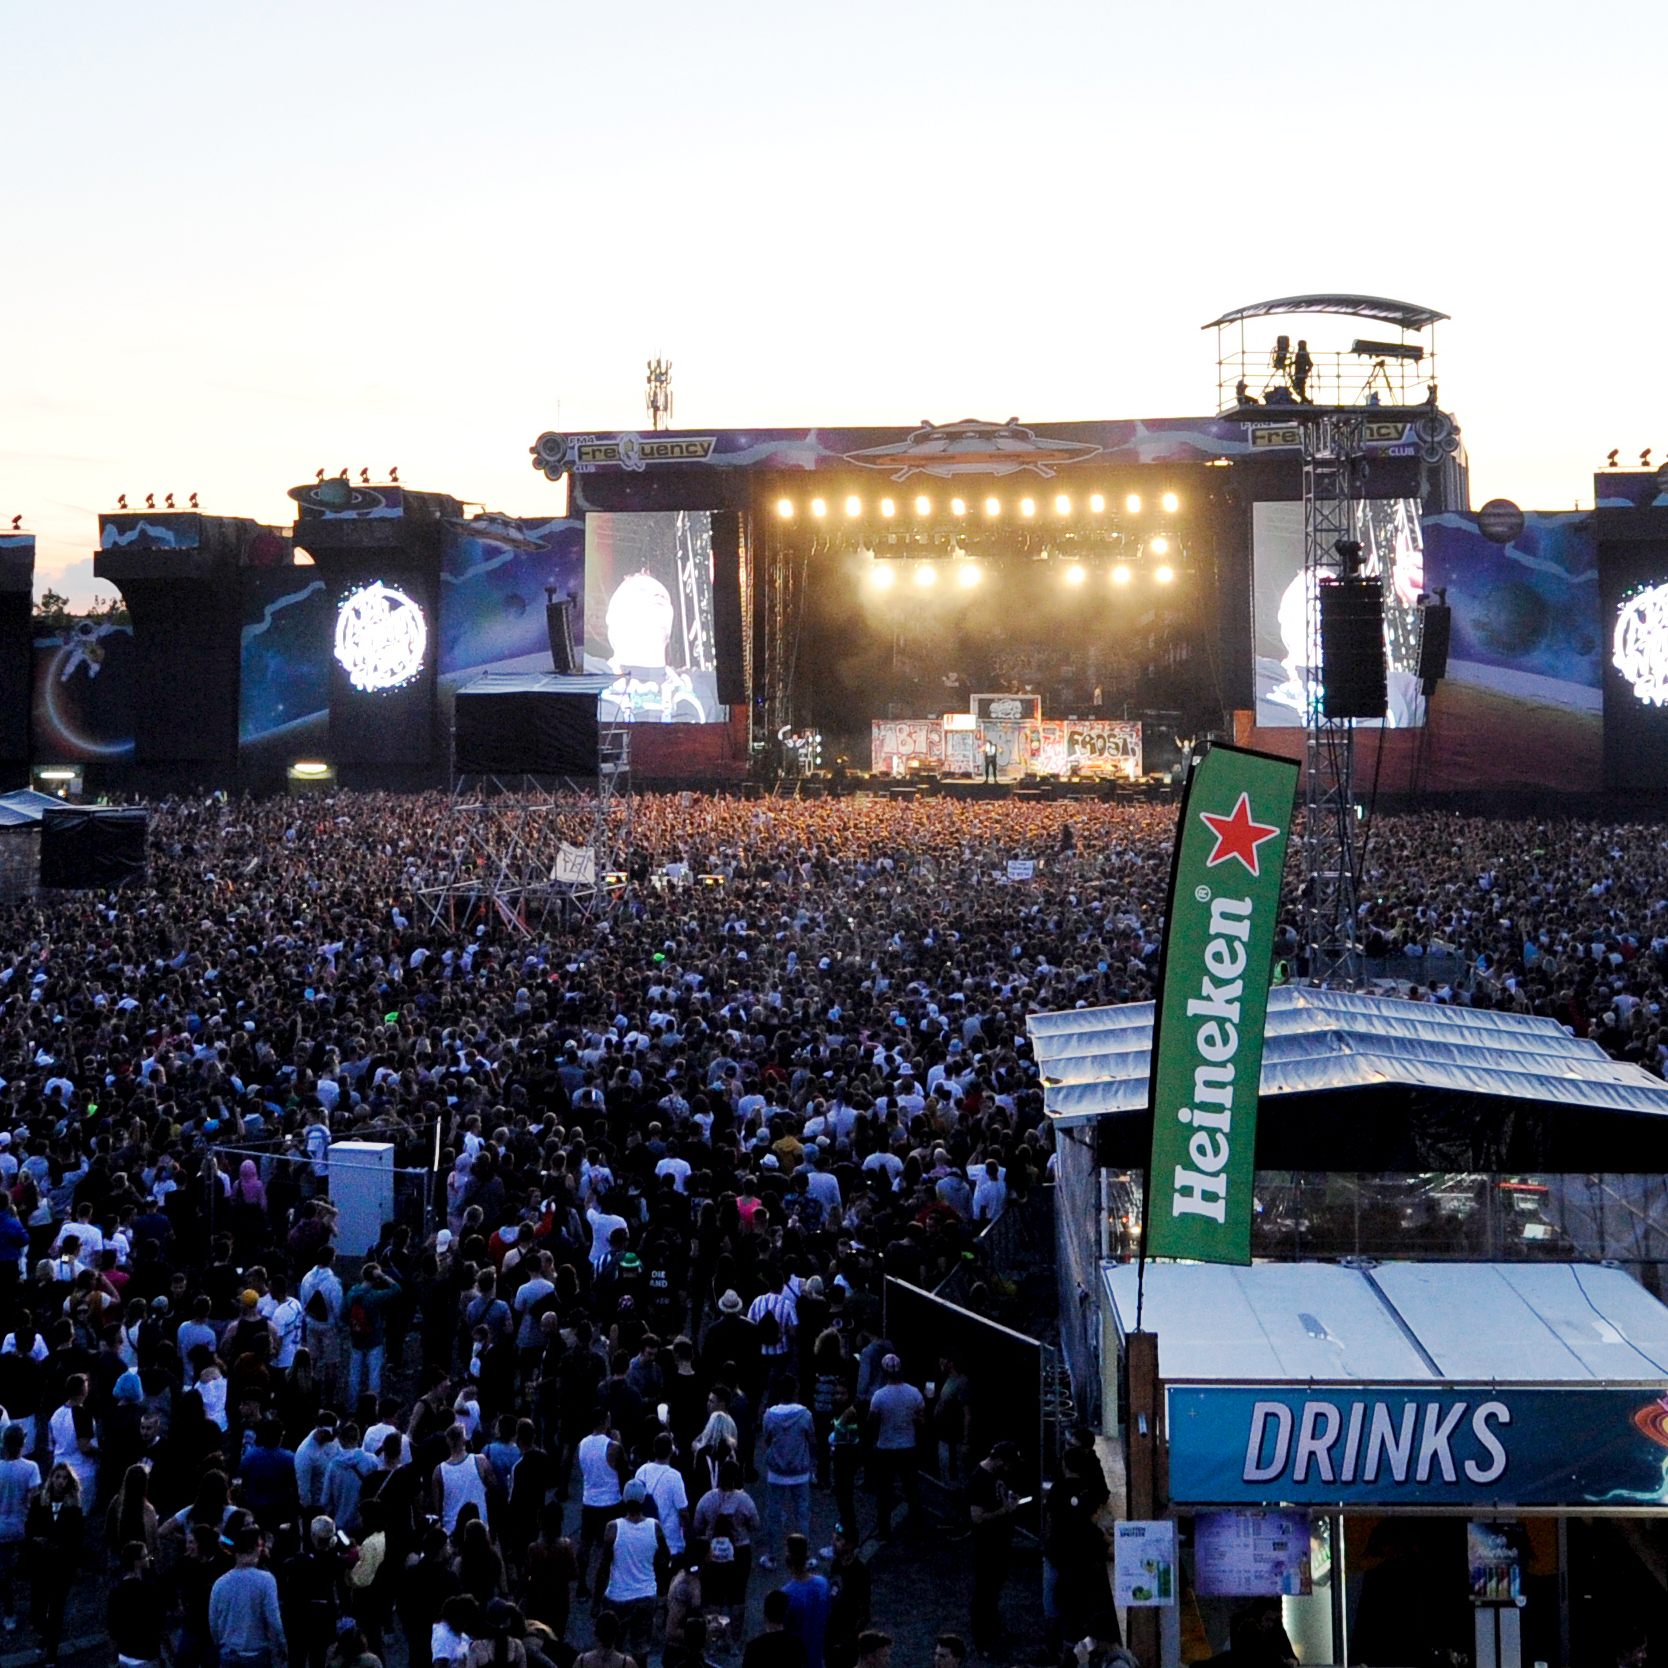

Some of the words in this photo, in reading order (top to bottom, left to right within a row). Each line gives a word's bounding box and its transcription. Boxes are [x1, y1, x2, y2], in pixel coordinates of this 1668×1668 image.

[1252, 423, 1406, 446] Frency
[1388, 447, 1415, 456] CLUB
[1172, 896, 1253, 1224] Heineken
[651, 1270, 666, 1279] DIE
[1242, 1401, 1511, 1484] DRINKS
